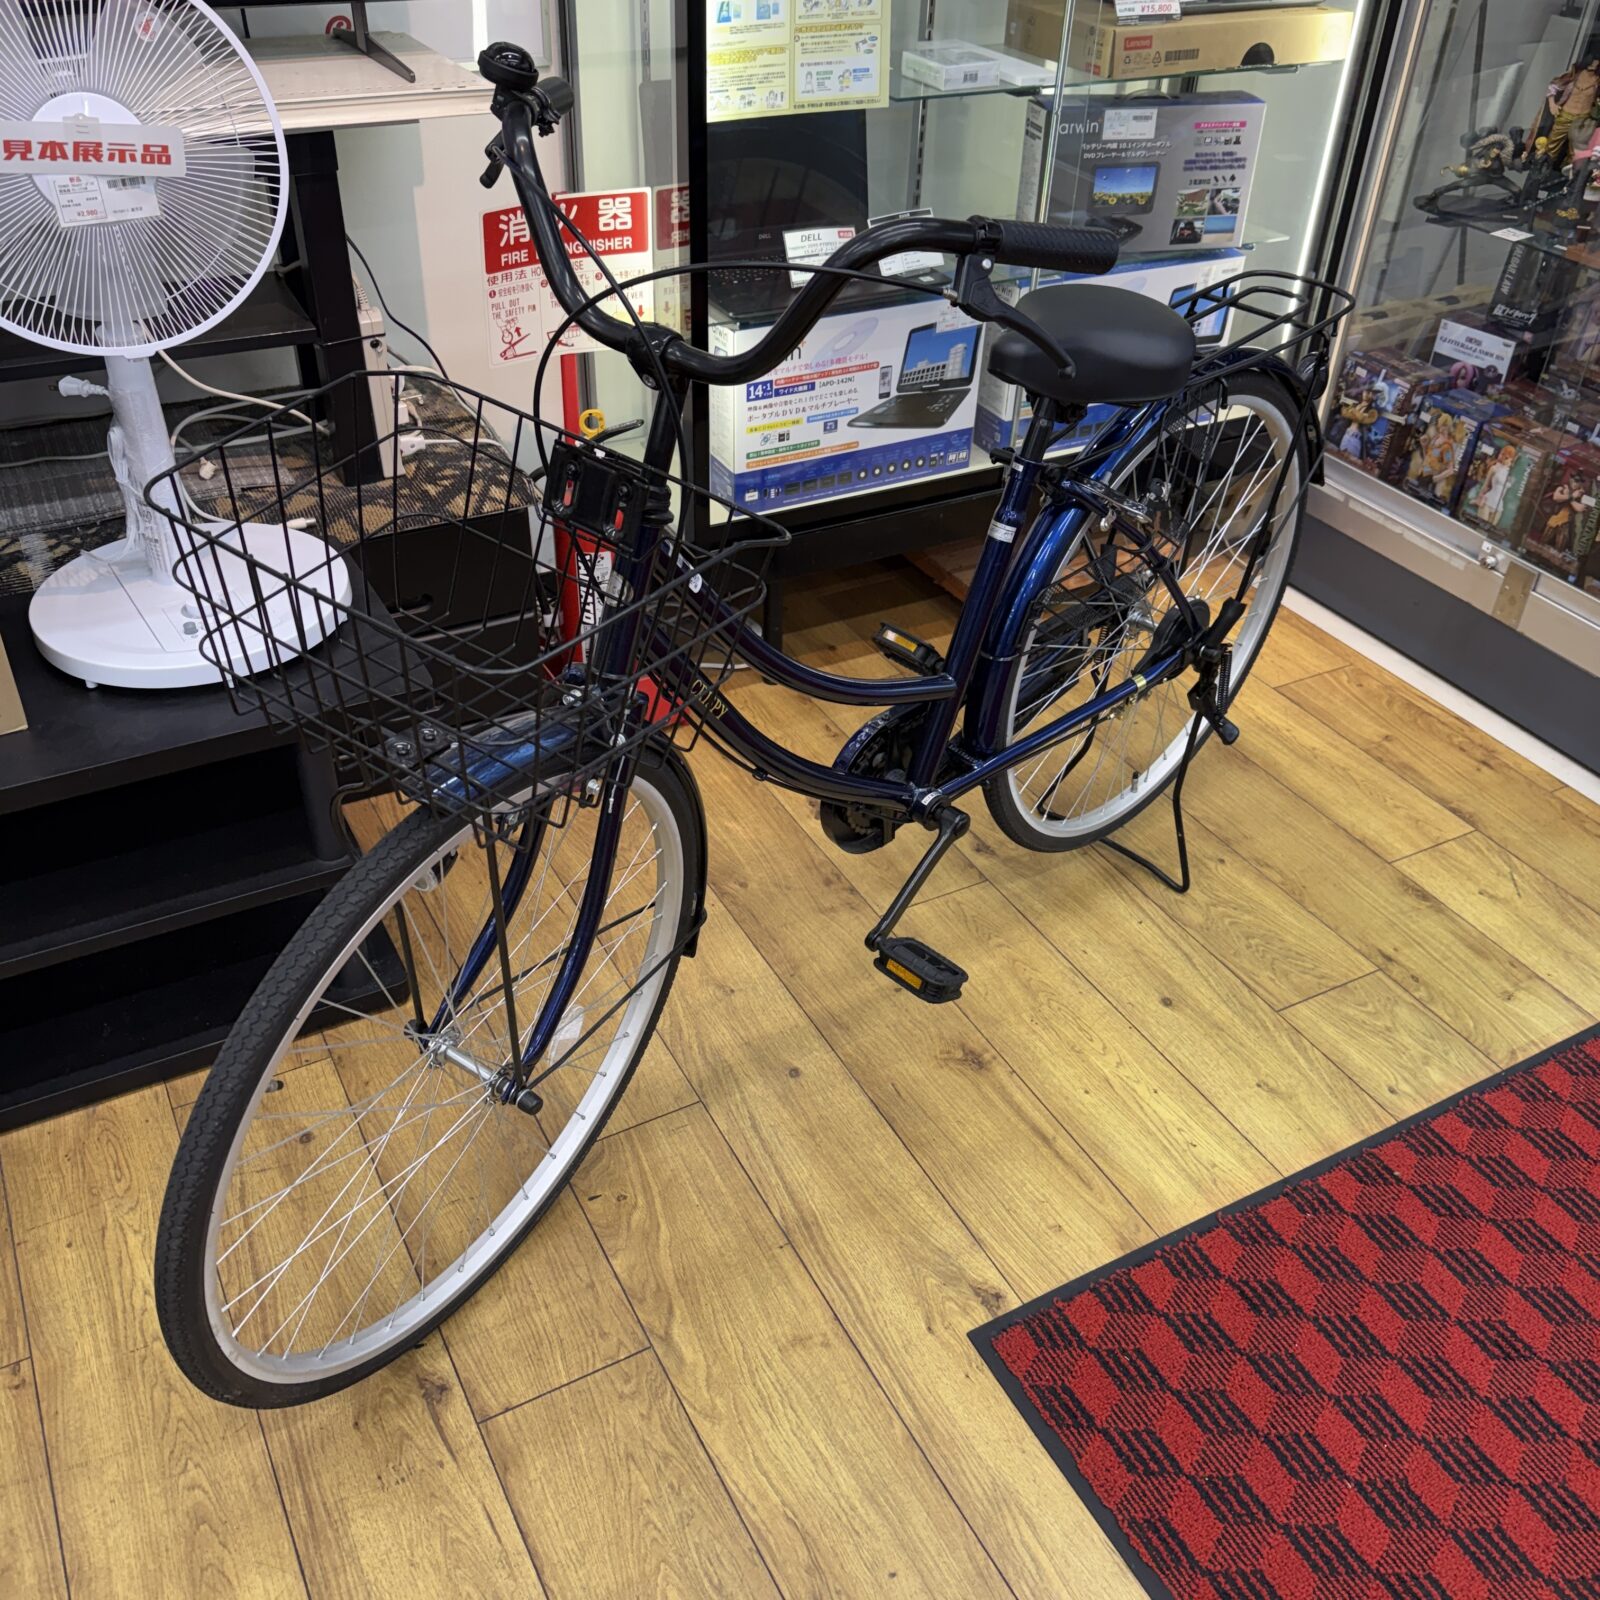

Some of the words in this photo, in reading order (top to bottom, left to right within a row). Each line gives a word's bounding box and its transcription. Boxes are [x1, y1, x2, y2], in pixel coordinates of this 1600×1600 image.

[2, 139, 172, 165] 見本展示品
[801, 232, 822, 242] DELL
[501, 249, 529, 267] FIRE
[487, 269, 527, 287] 使用法
